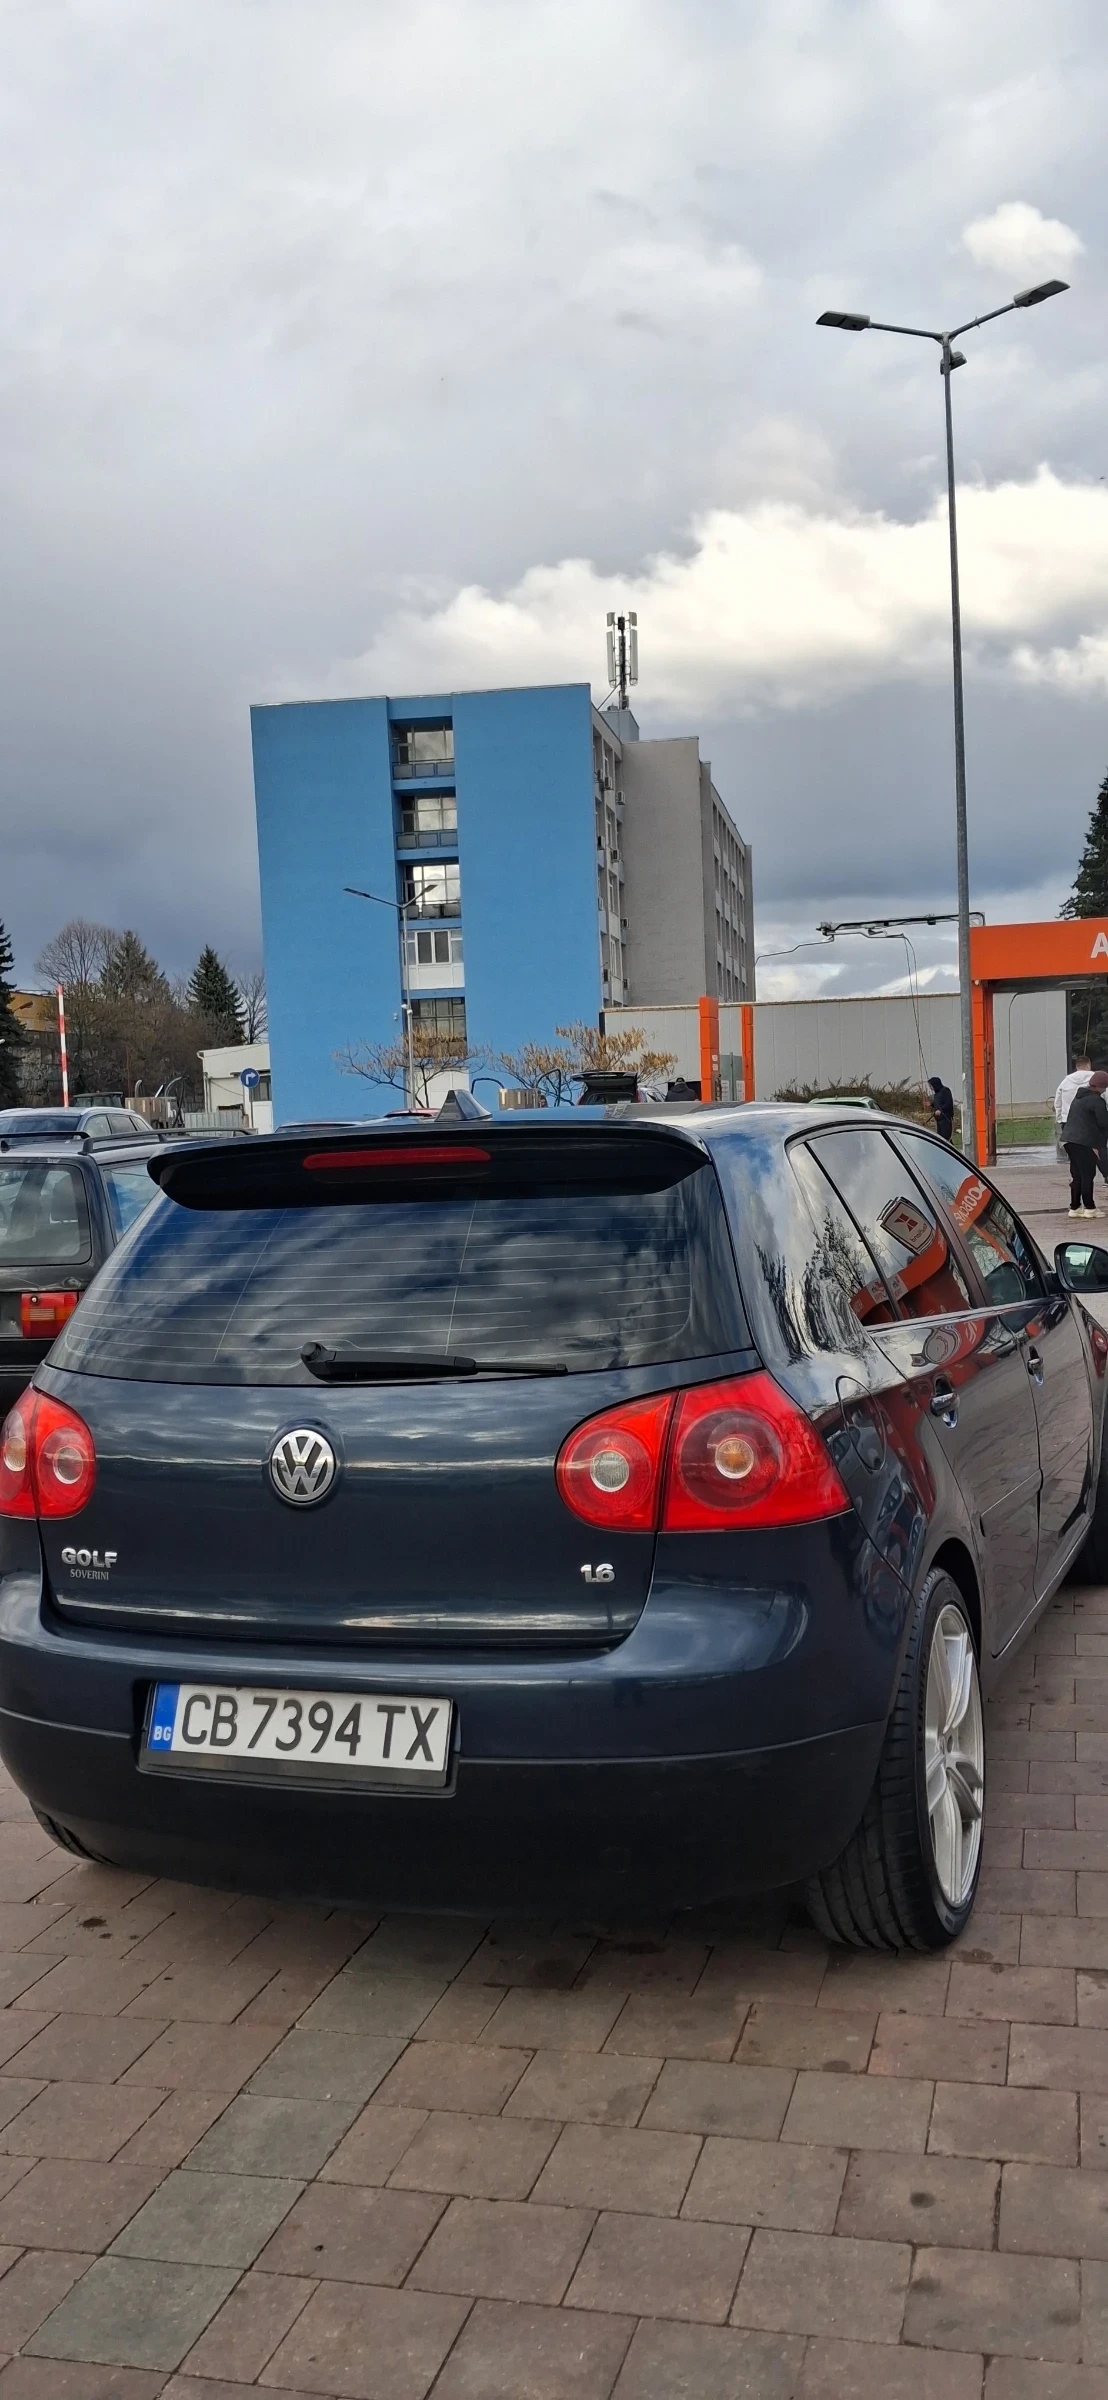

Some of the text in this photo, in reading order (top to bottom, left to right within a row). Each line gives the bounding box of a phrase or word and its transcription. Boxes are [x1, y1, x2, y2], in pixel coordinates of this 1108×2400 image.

[61, 1547, 118, 1569] GOLF
[69, 1568, 110, 1581] SOVERINI
[153, 1724, 173, 1742] BG
